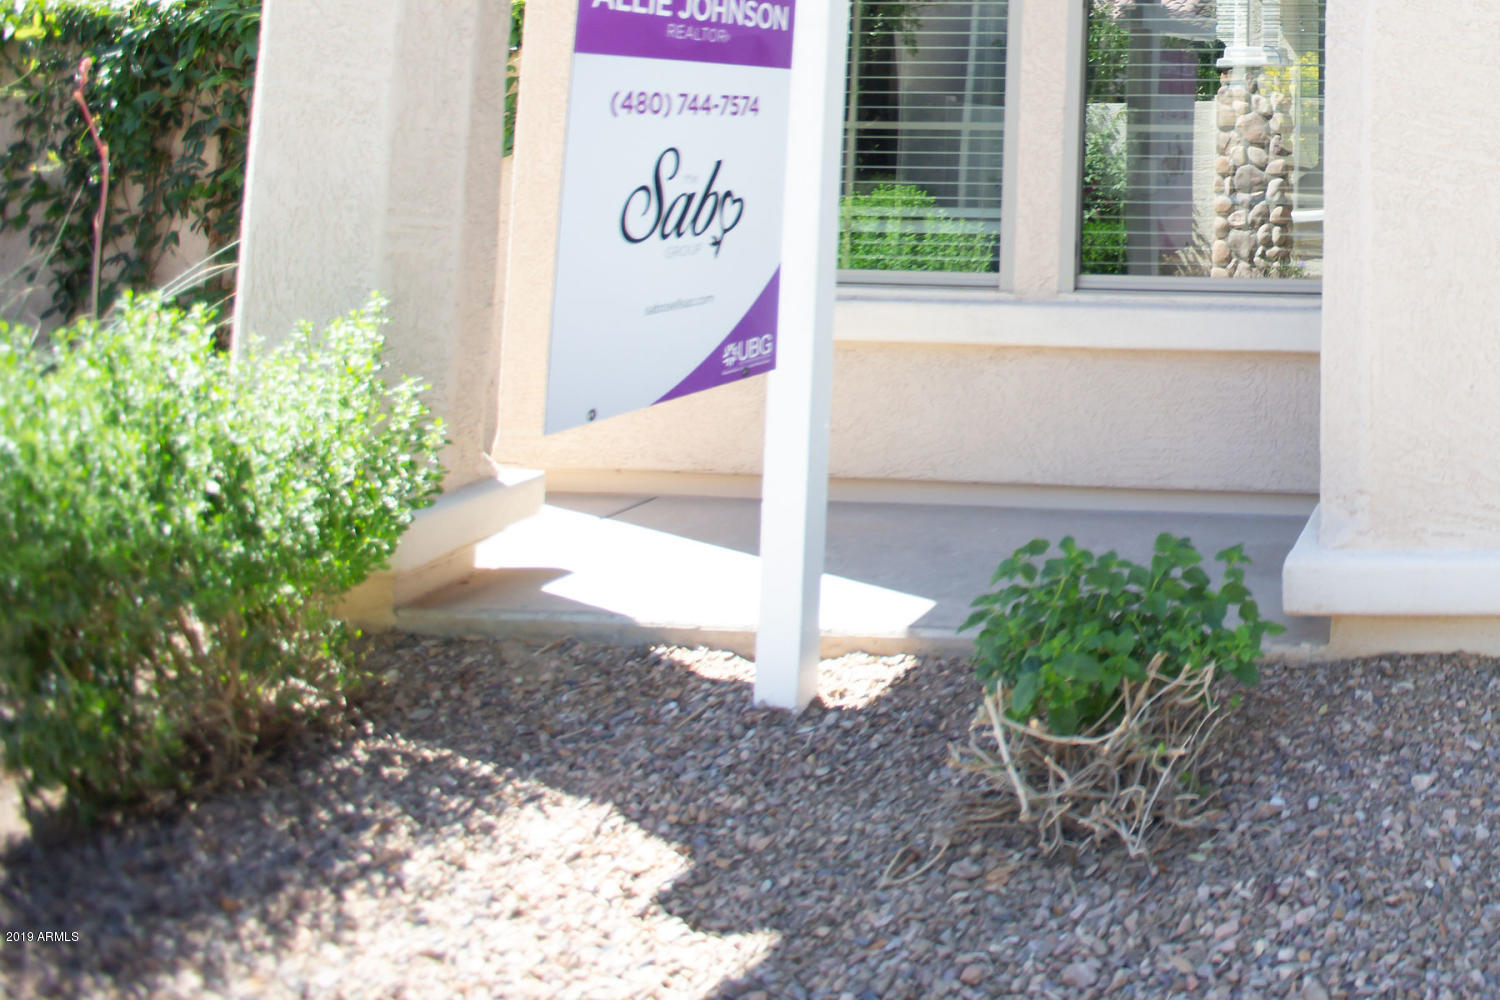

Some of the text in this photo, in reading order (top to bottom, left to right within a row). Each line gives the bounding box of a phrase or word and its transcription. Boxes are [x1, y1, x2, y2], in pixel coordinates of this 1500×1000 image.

[610, 91, 759, 118] (480) 744-7574
[736, 333, 774, 362] UBG
